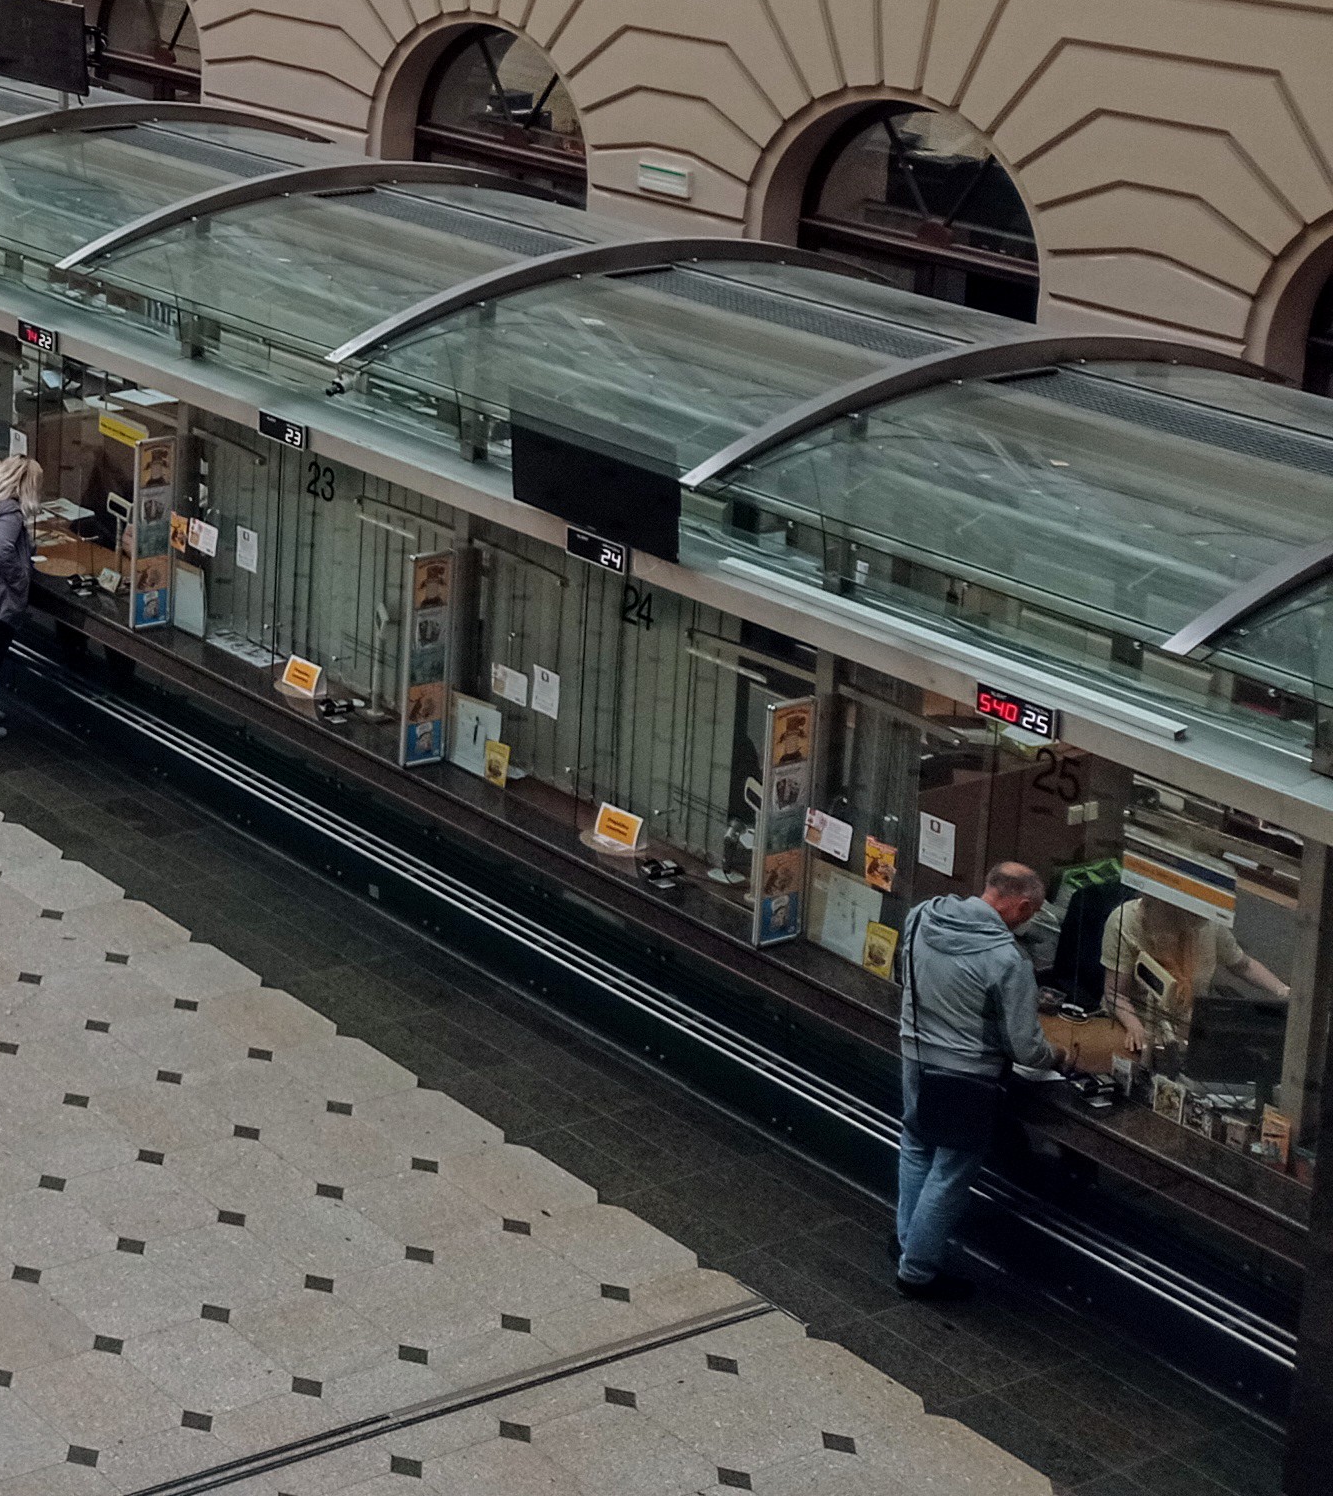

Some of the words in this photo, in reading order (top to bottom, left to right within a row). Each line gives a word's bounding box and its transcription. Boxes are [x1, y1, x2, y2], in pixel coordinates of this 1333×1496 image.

[38, 334, 52, 349] 22
[284, 428, 302, 446] 23
[307, 461, 335, 502] 23
[600, 548, 622, 569] 24
[622, 585, 654, 631] 24
[979, 693, 1018, 723] 540
[1022, 709, 1049, 734] 25
[1033, 747, 1081, 802] 25
